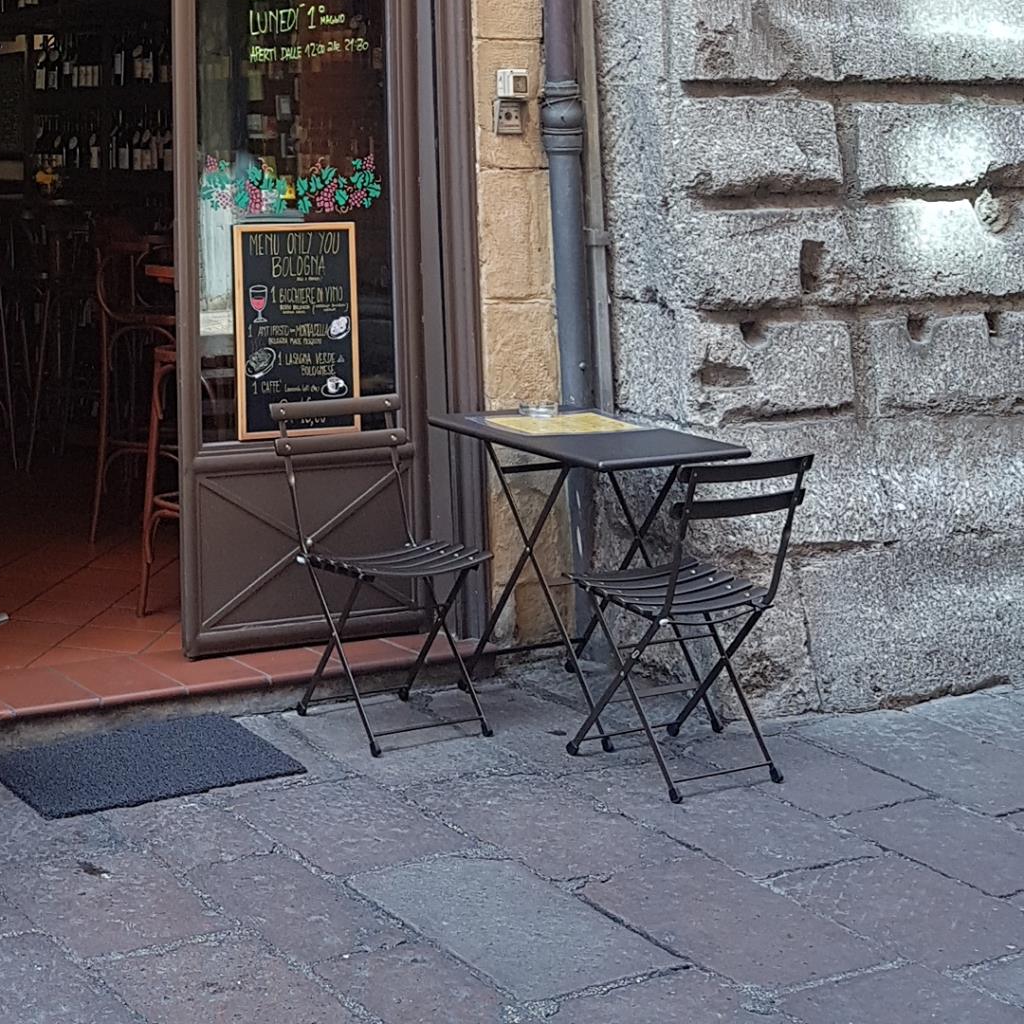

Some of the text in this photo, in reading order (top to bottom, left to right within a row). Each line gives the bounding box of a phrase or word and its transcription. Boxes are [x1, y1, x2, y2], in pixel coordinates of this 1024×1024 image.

[250, 45, 277, 63] APERTI
[280, 46, 303, 60] DALLE
[249, 231, 341, 256] MENU ONLY YOU
[271, 255, 326, 278] BOLOGNA
[270, 285, 276, 304] 1
[325, 285, 344, 302] VINO
[277, 351, 283, 366] 1
[252, 380, 258, 395] 1
